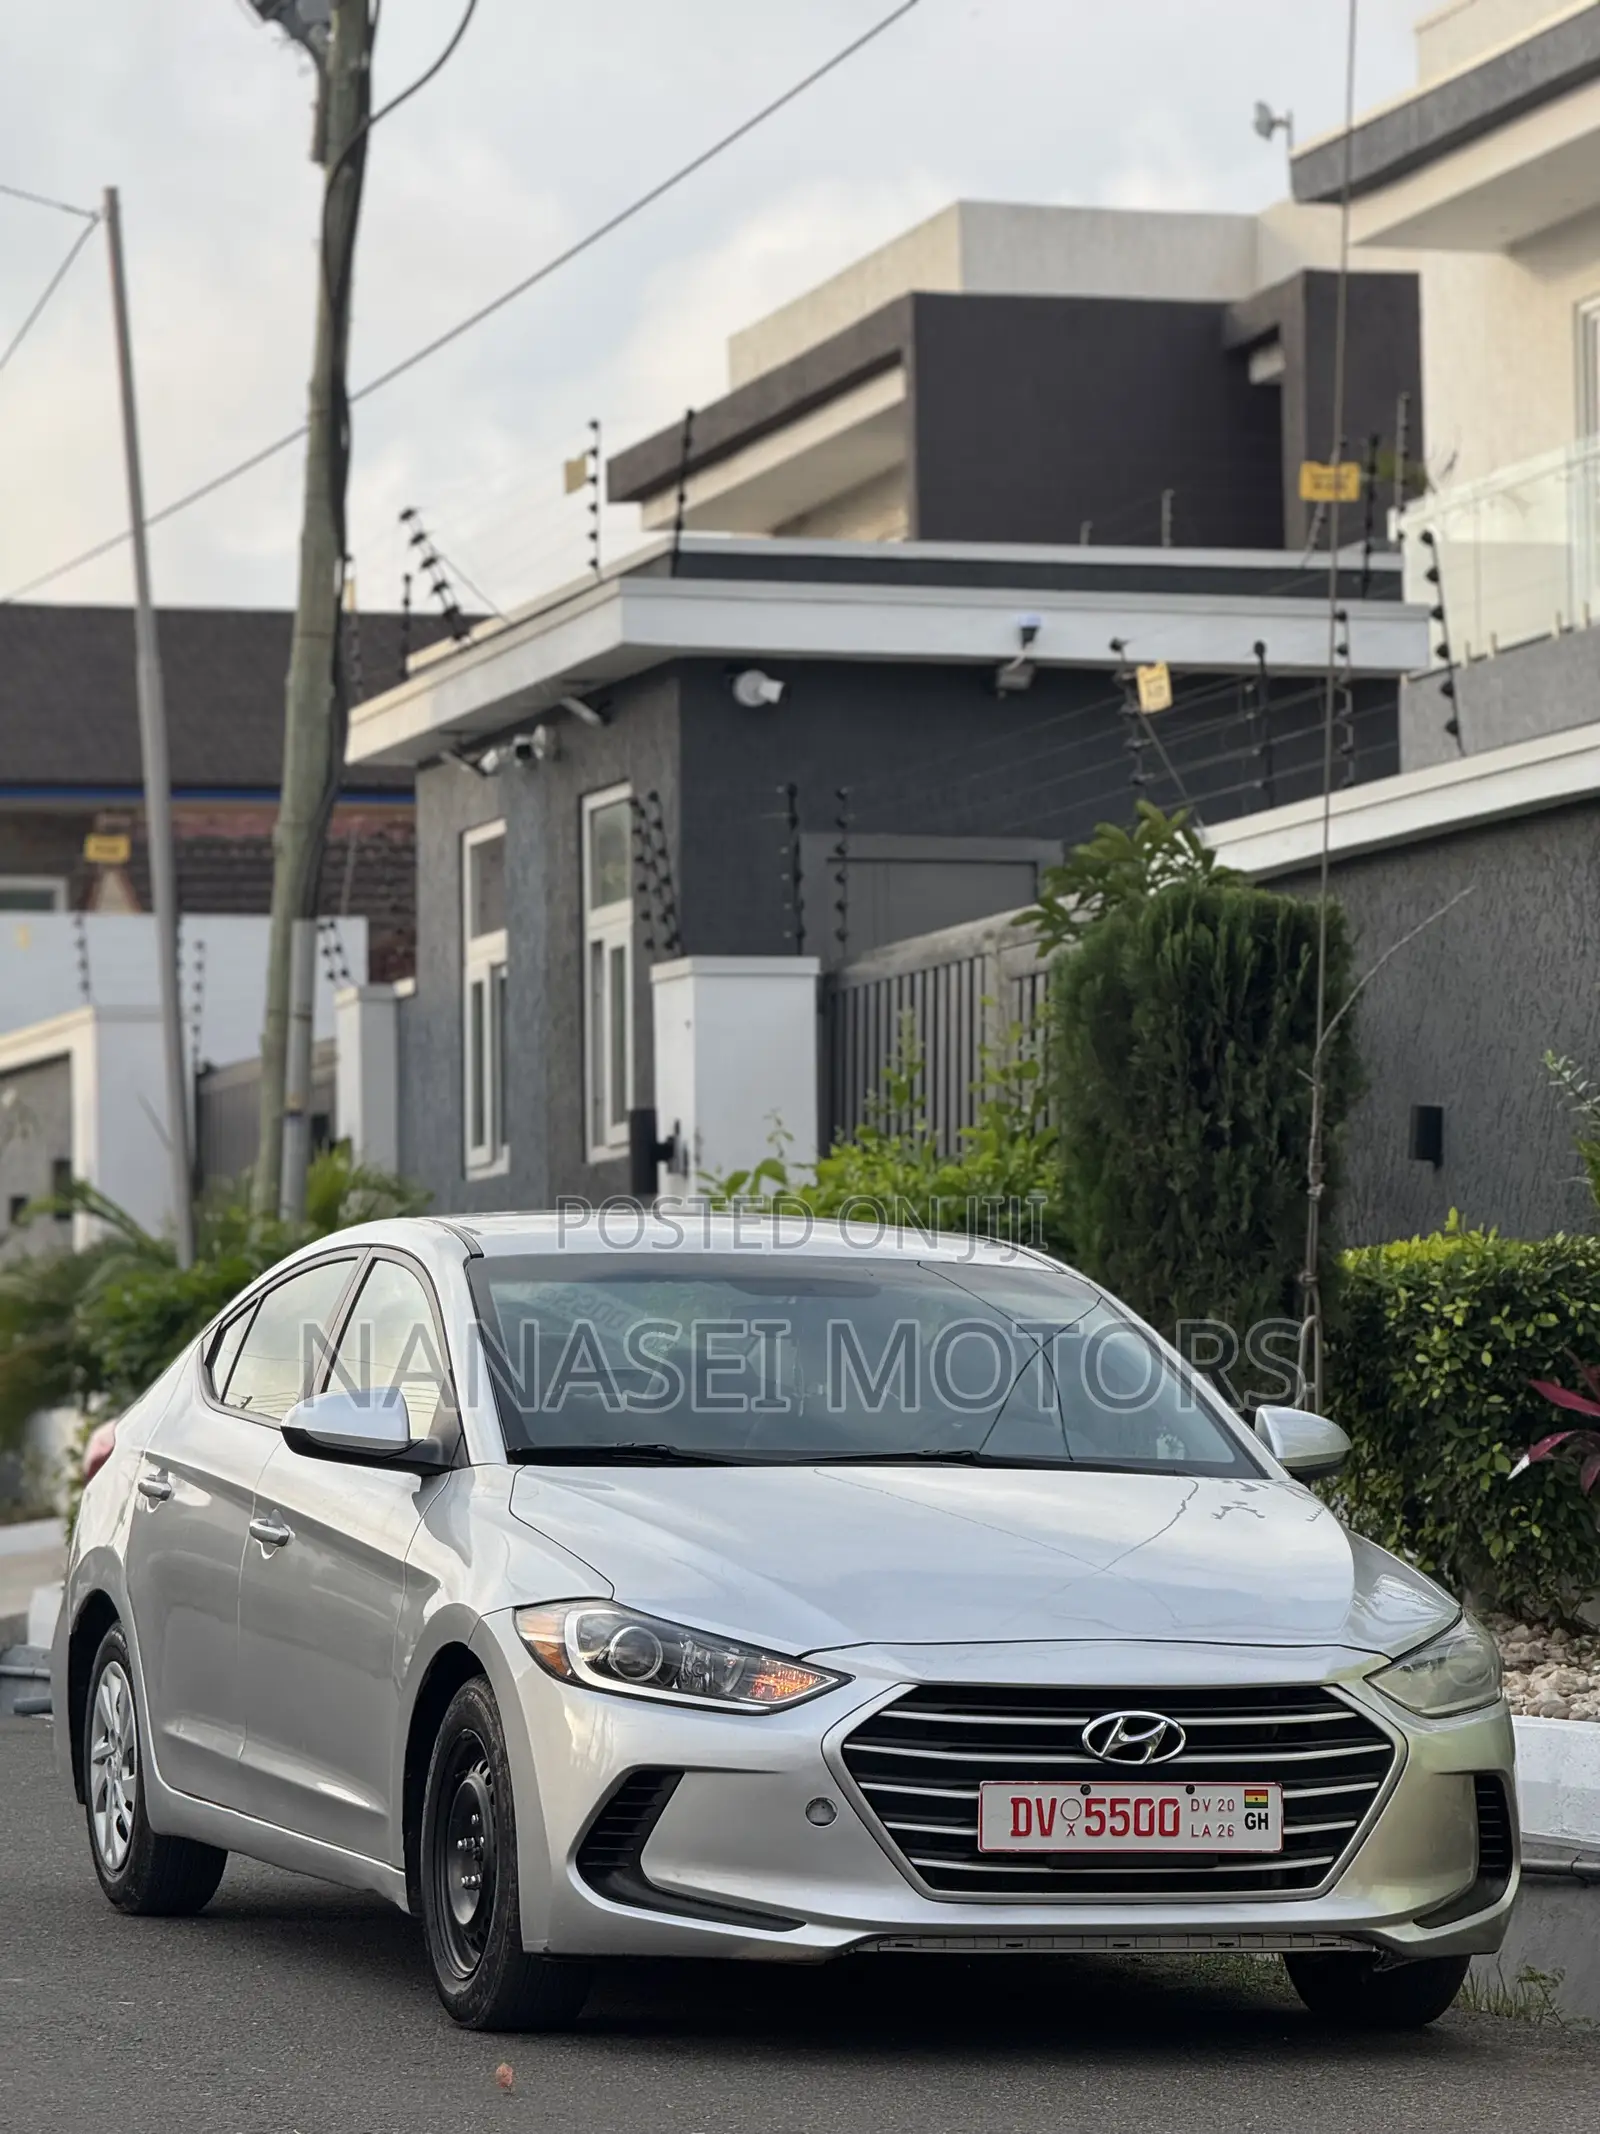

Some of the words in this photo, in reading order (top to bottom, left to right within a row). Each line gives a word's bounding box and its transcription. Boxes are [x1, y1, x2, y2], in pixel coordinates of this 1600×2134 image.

[1190, 1798, 1212, 1812] DV
[1217, 1798, 1235, 1812] 20
[1010, 1797, 1057, 1837] DV
[1084, 1797, 1180, 1837] 5500
[1244, 1812, 1269, 1831] GH
[1190, 1824, 1213, 1838] LA
[1217, 1824, 1235, 1838] 26
